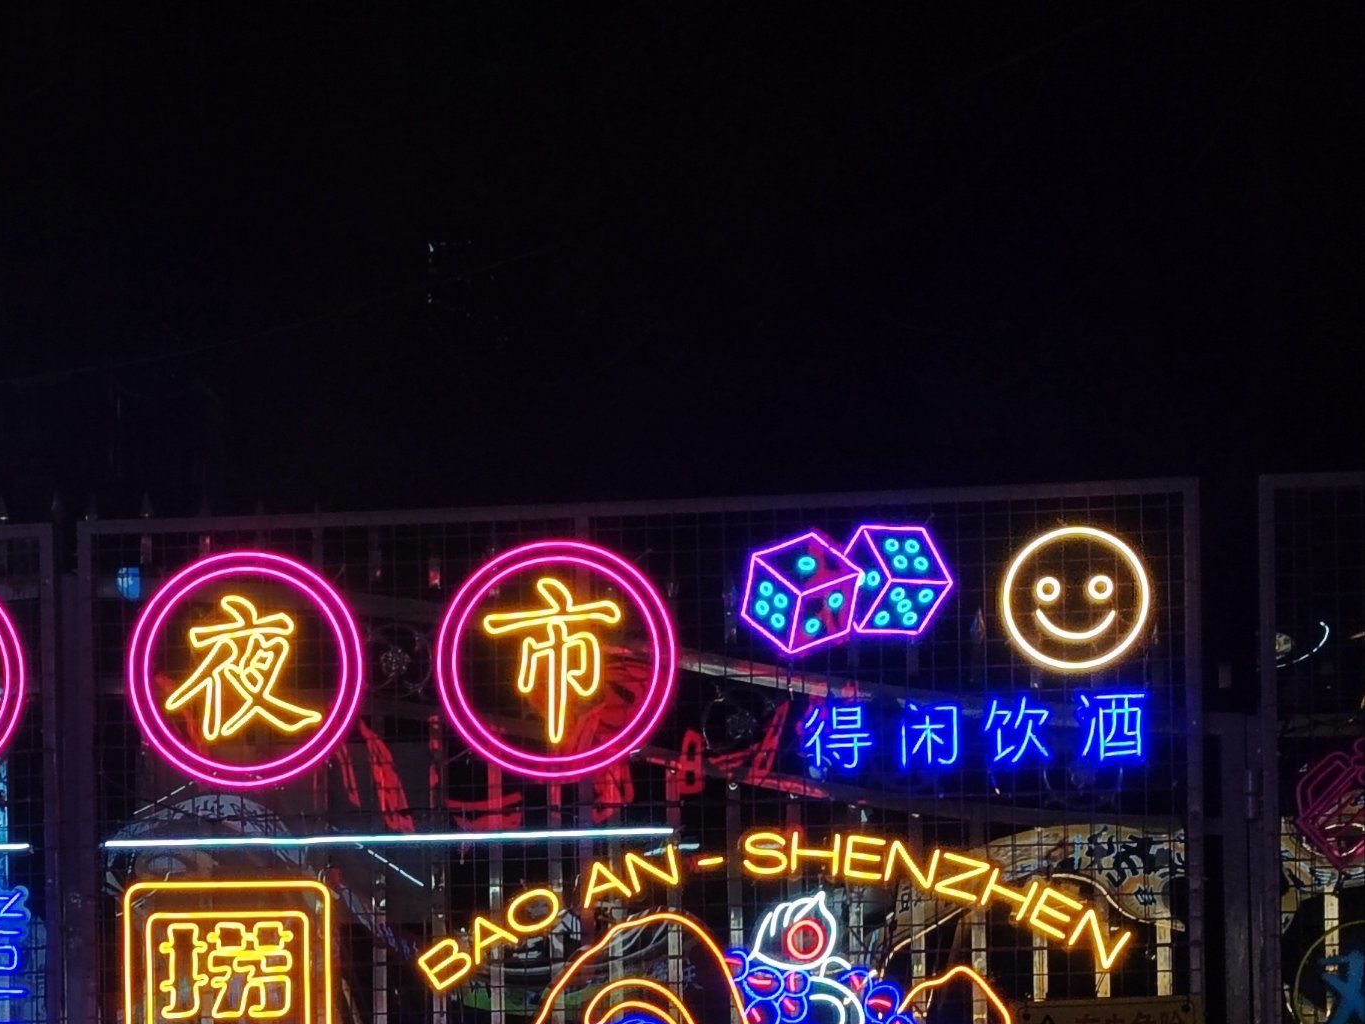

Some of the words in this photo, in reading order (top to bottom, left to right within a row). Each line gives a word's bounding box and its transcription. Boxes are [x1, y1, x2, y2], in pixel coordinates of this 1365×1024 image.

[803, 692, 1146, 769] 得闲饮酒
[417, 888, 560, 991] BAO
[583, 843, 680, 909] AN
[742, 831, 1132, 970] SHENZHEN
